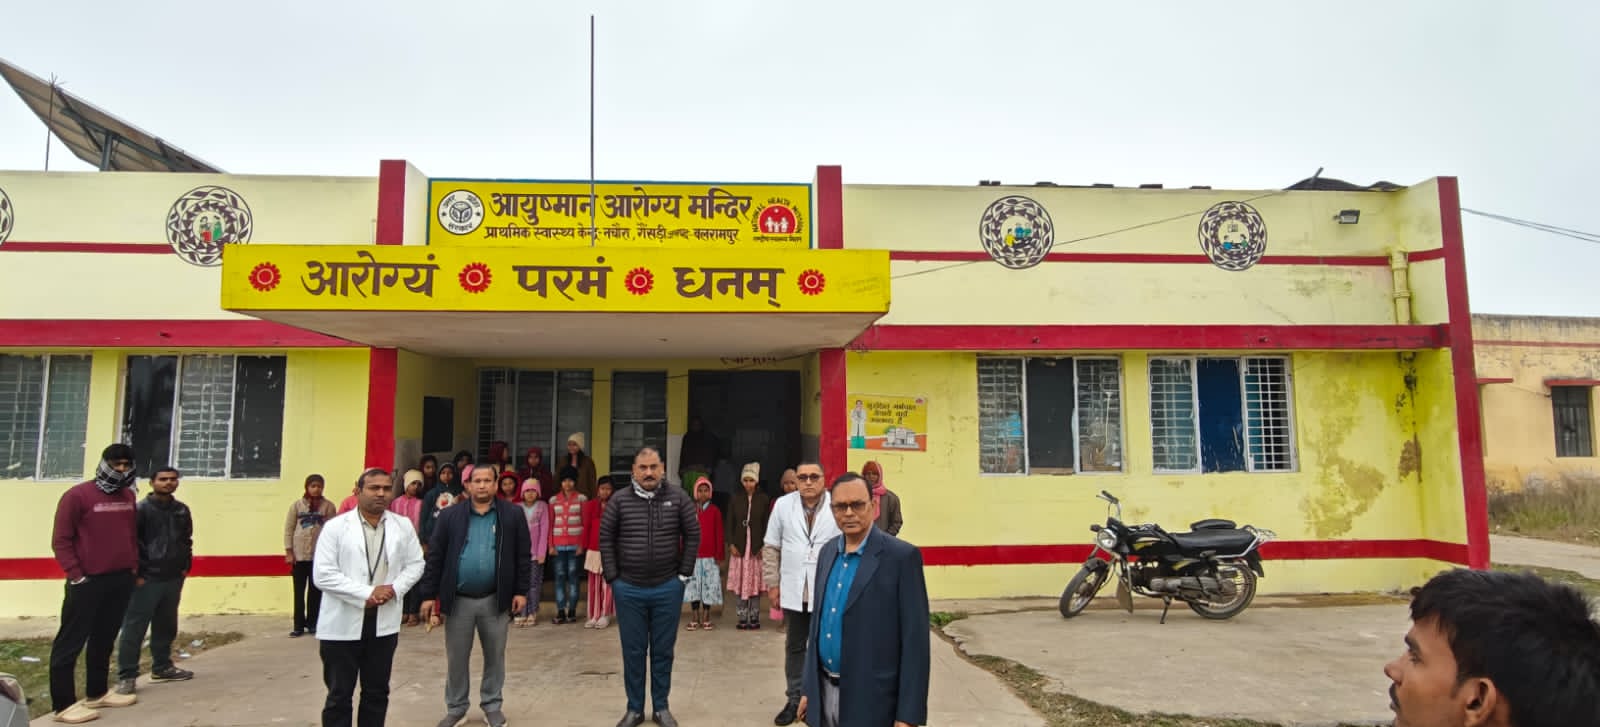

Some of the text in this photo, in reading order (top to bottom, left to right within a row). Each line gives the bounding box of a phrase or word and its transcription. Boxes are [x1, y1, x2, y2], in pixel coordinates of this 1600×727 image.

[489, 186, 753, 226] आयुष्मान आरोग्य मन्दिर
[484, 222, 531, 239] प्राथमिक
[533, 227, 576, 241] स्वास्थ्य
[300, 250, 439, 299] आरोग्यं
[513, 256, 613, 302] परमं
[674, 267, 785, 307] धनम्
